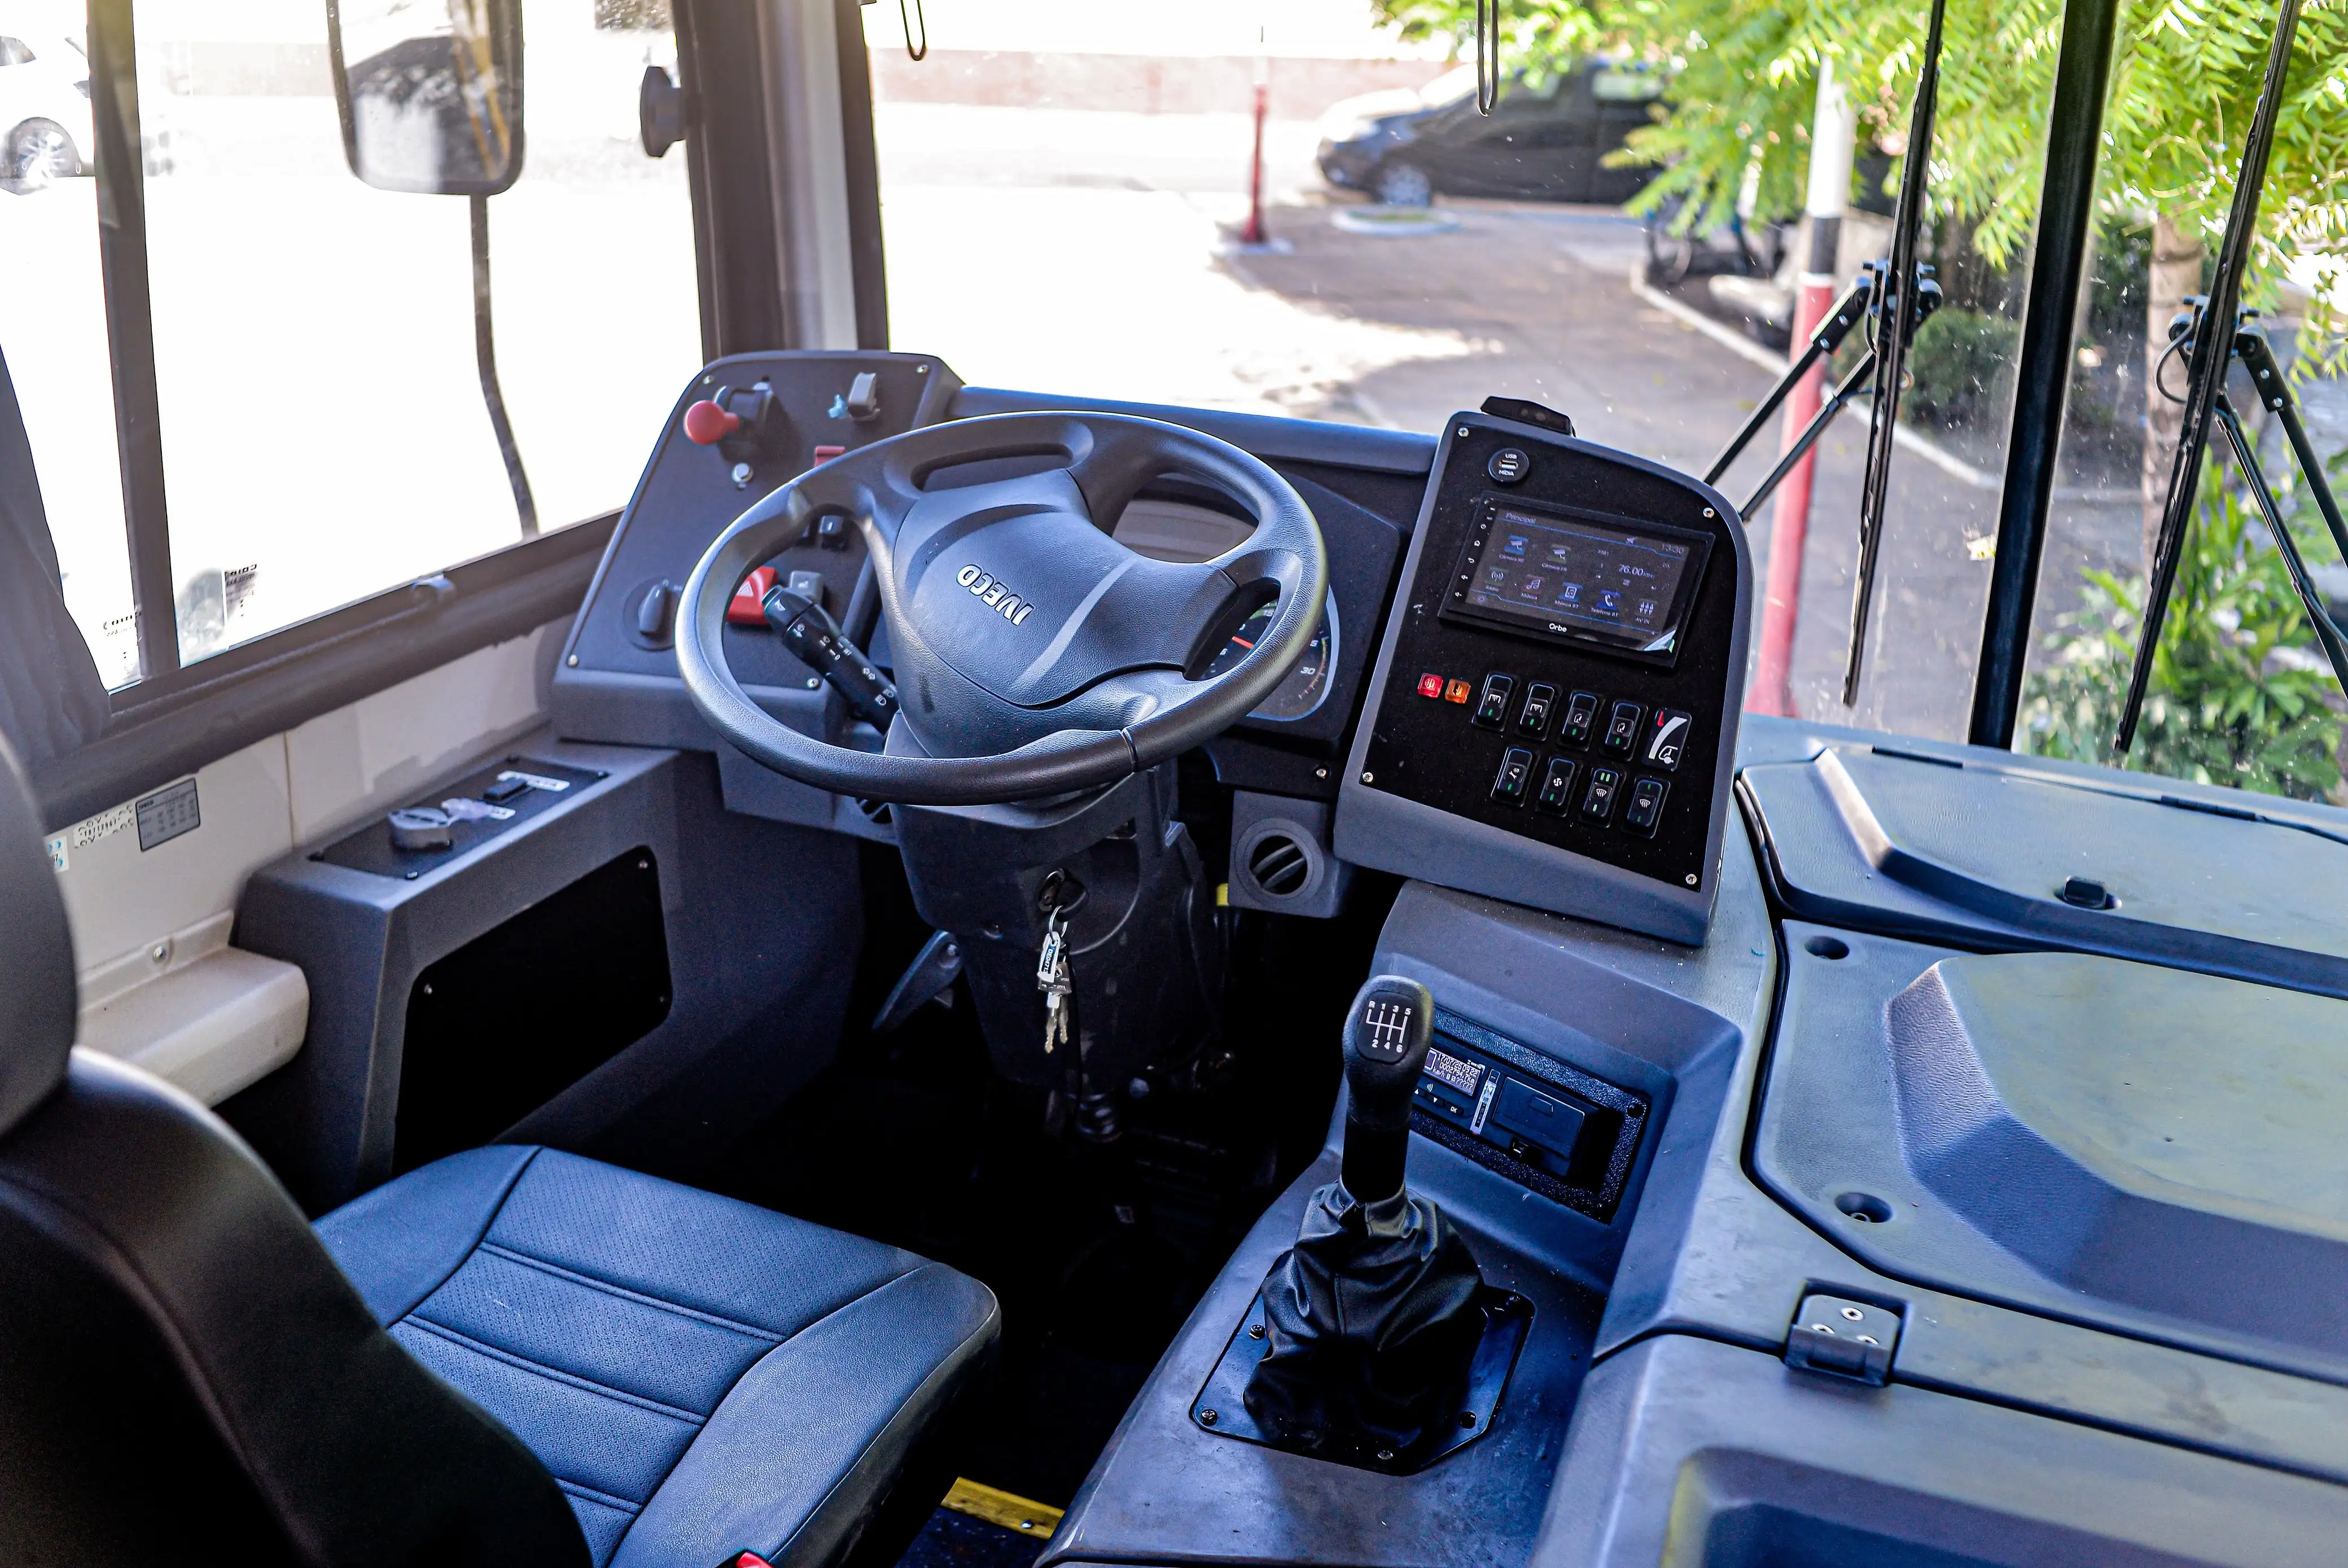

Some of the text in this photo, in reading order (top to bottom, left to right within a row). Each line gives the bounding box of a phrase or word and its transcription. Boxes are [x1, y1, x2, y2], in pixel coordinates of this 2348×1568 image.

[956, 564, 1035, 627] IVECO
[1549, 623, 1567, 633] Orbe
[1300, 667, 1316, 675] 30
[1368, 1000, 1375, 1009] R
[1372, 1039, 1403, 1053] 2 4 6
[1432, 1066, 1445, 1078] km/h
